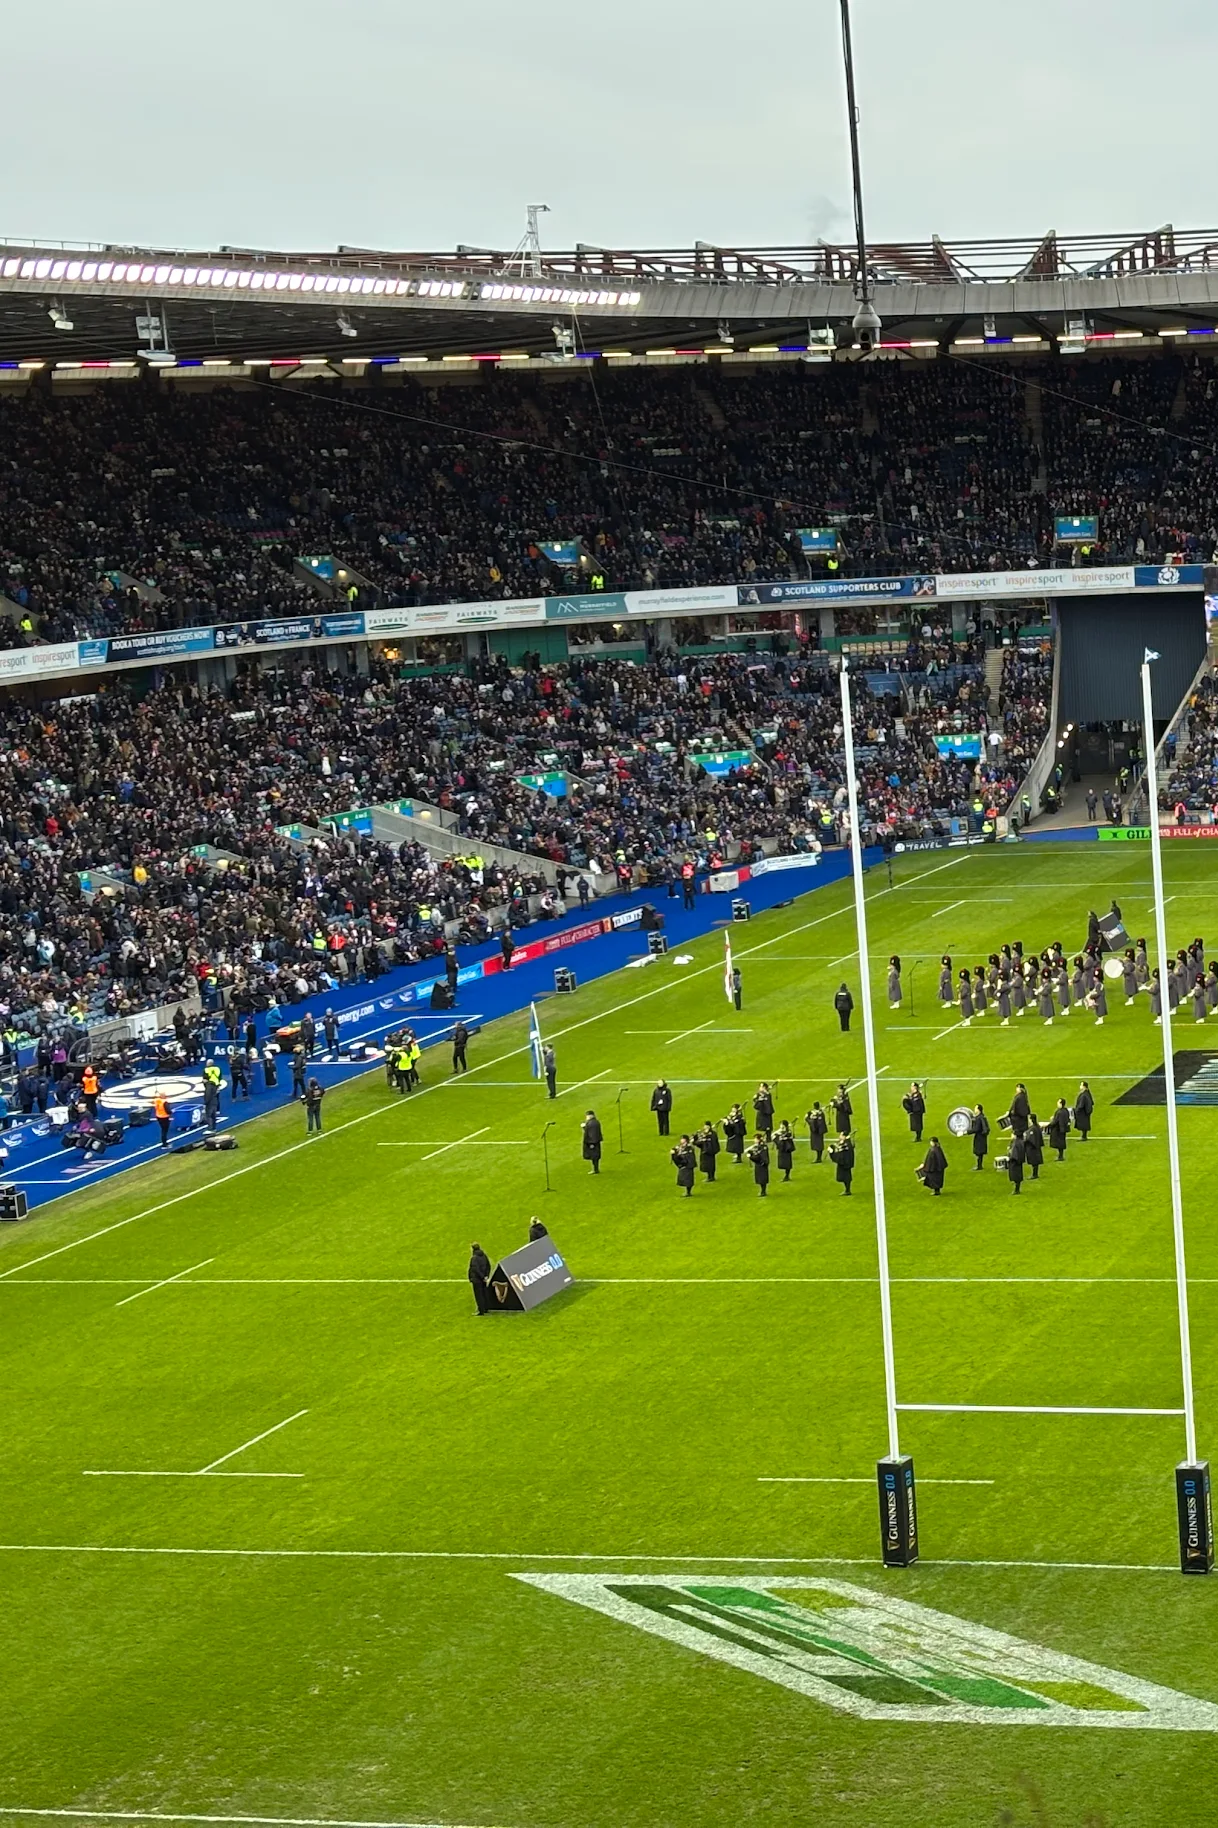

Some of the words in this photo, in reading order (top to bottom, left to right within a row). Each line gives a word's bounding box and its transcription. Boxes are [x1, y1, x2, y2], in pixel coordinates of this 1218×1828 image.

[938, 577, 998, 589] inspiresport
[1005, 574, 1063, 586] inspiresport
[1072, 572, 1130, 583] inspiresport
[785, 586, 826, 595] SCOTLAND
[828, 583, 879, 594] SUPPORTERS
[880, 582, 901, 591] CLUB
[32, 650, 75, 665] inspiresport
[1174, 828, 1192, 836] FULL
[1193, 828, 1201, 837] of
[214, 1045, 226, 1055] As
[885, 1474, 896, 1489] 0.0
[1185, 1480, 1196, 1495] 0.0
[887, 1490, 899, 1540] GUINNESS
[1187, 1497, 1199, 1547] GUINNESS
